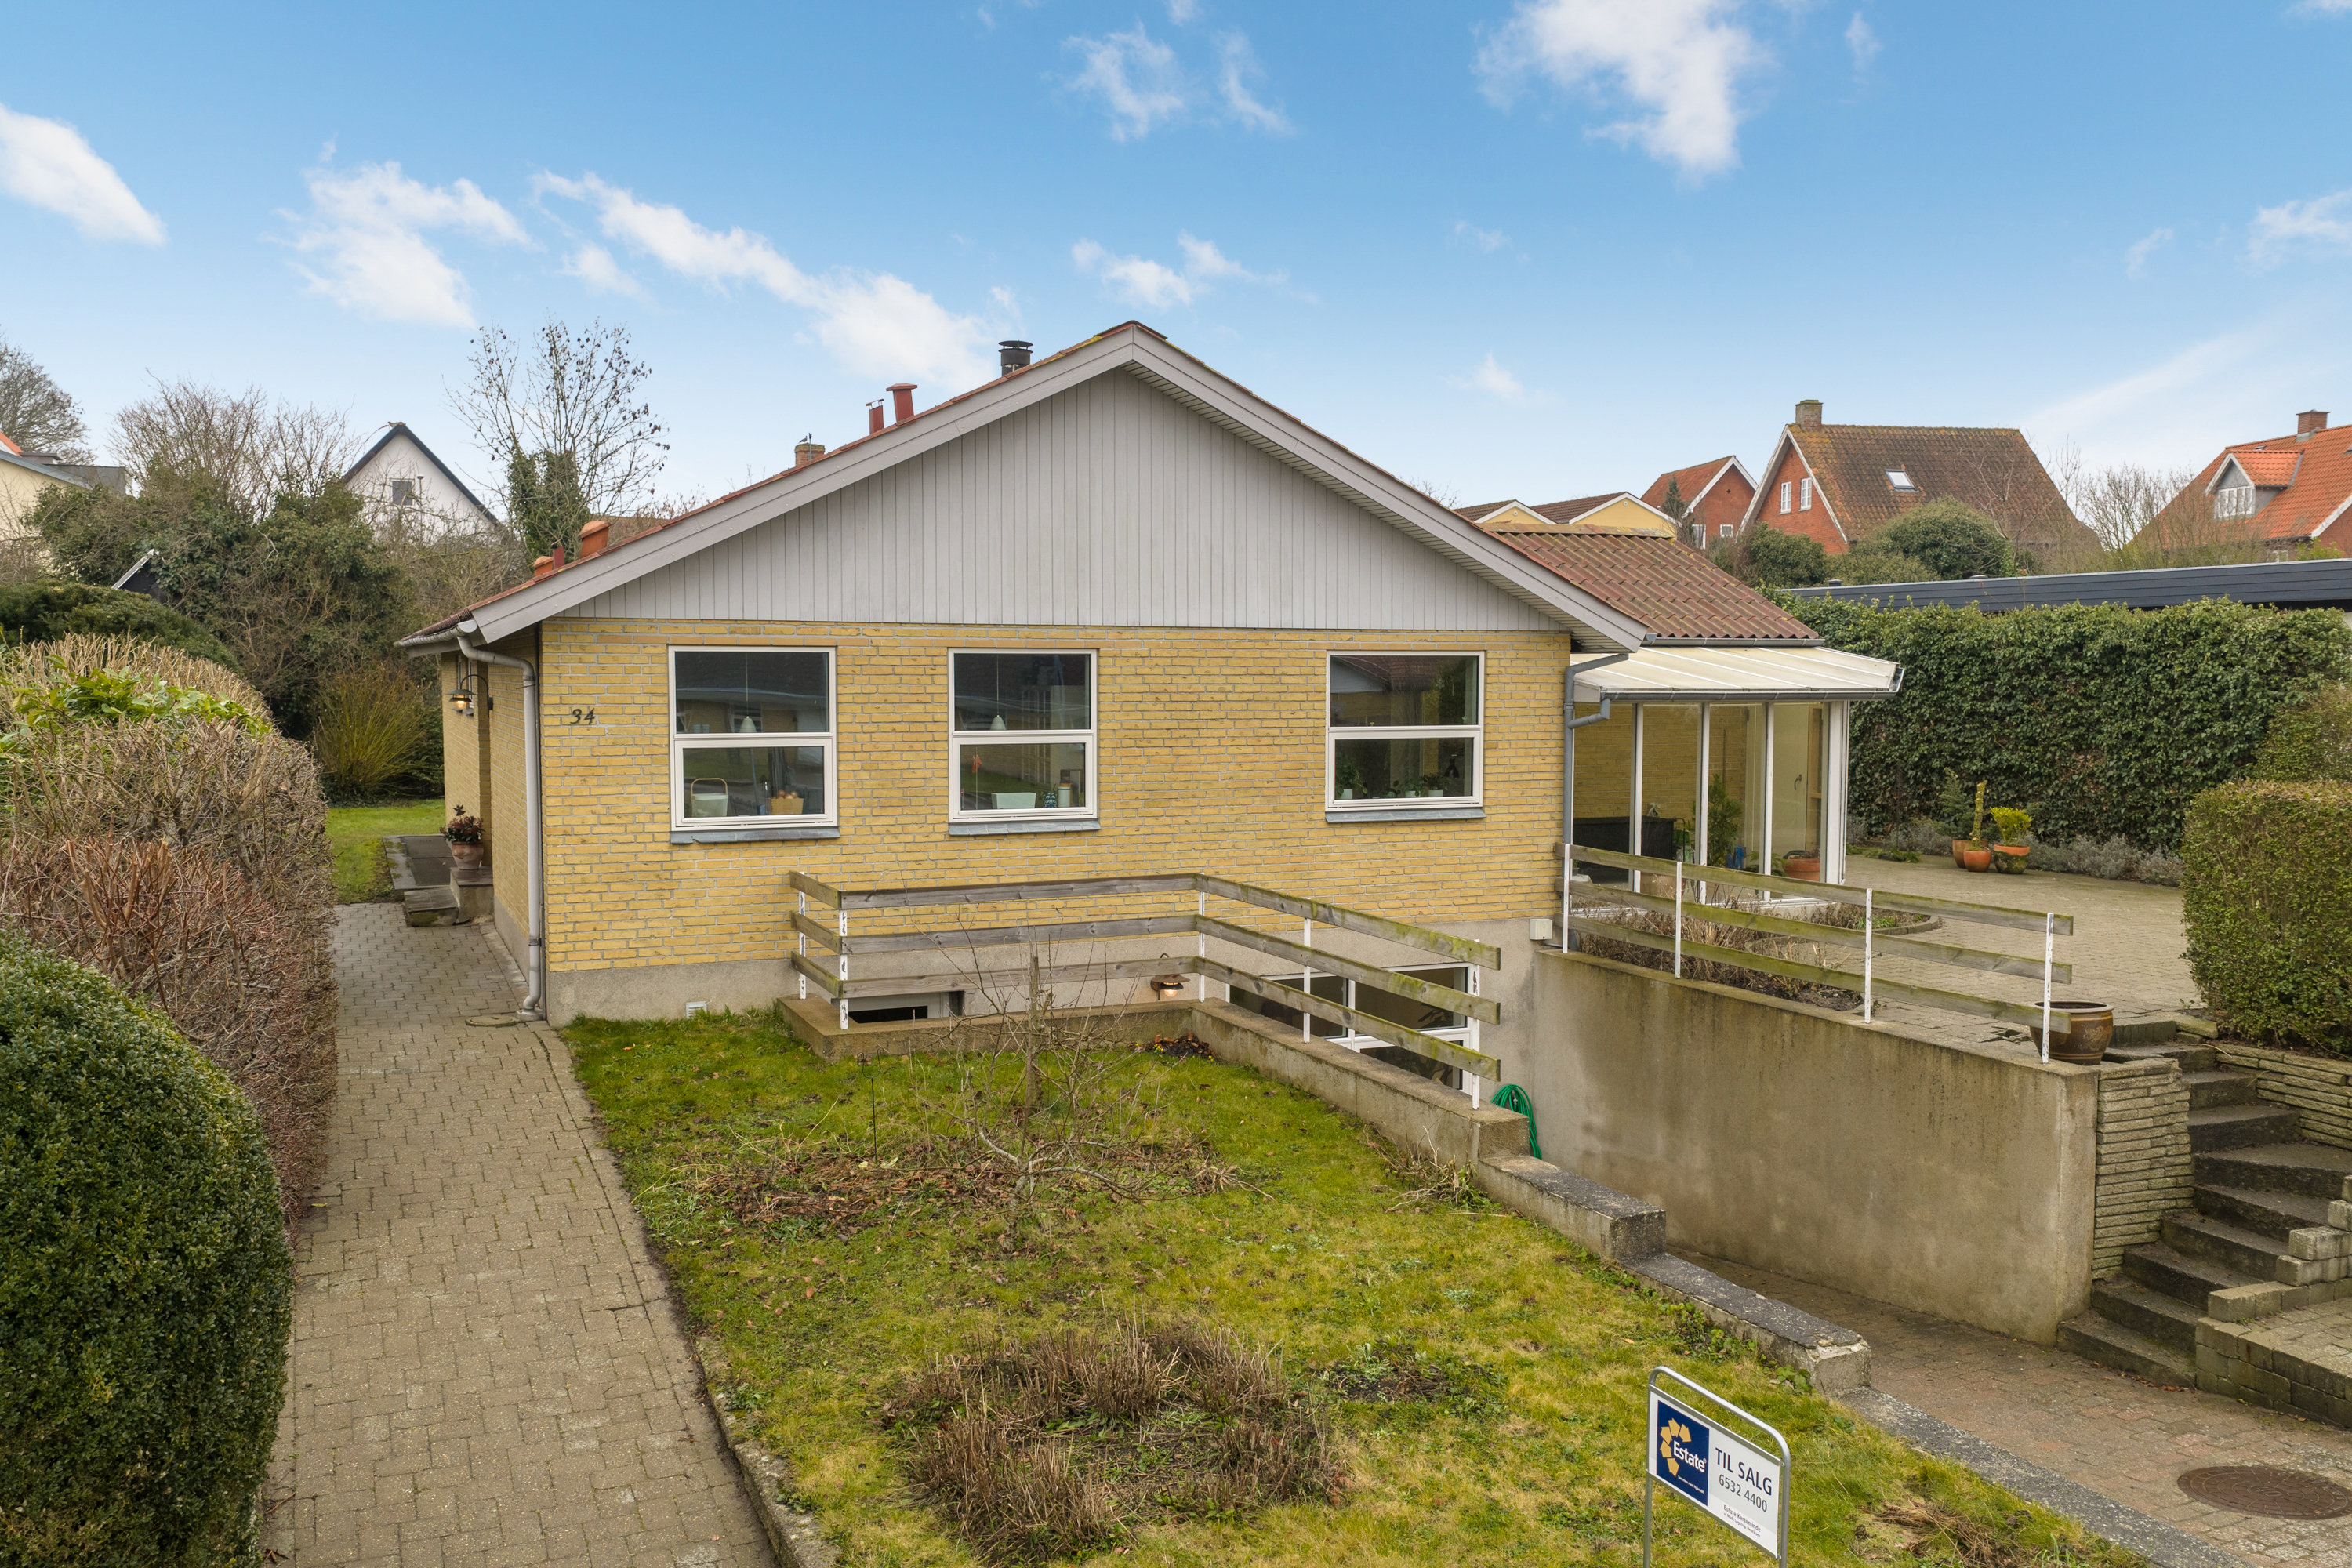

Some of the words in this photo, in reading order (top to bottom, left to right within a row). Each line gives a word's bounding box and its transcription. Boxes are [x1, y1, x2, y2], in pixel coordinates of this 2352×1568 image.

[570, 707, 596, 725] 34
[1715, 1447, 1733, 1473] TIL
[1738, 1461, 1772, 1496] SALG
[1719, 1474, 1741, 1497] 6532
[1744, 1490, 1767, 1512] 4400
[1724, 1505, 1737, 1517] Estate
